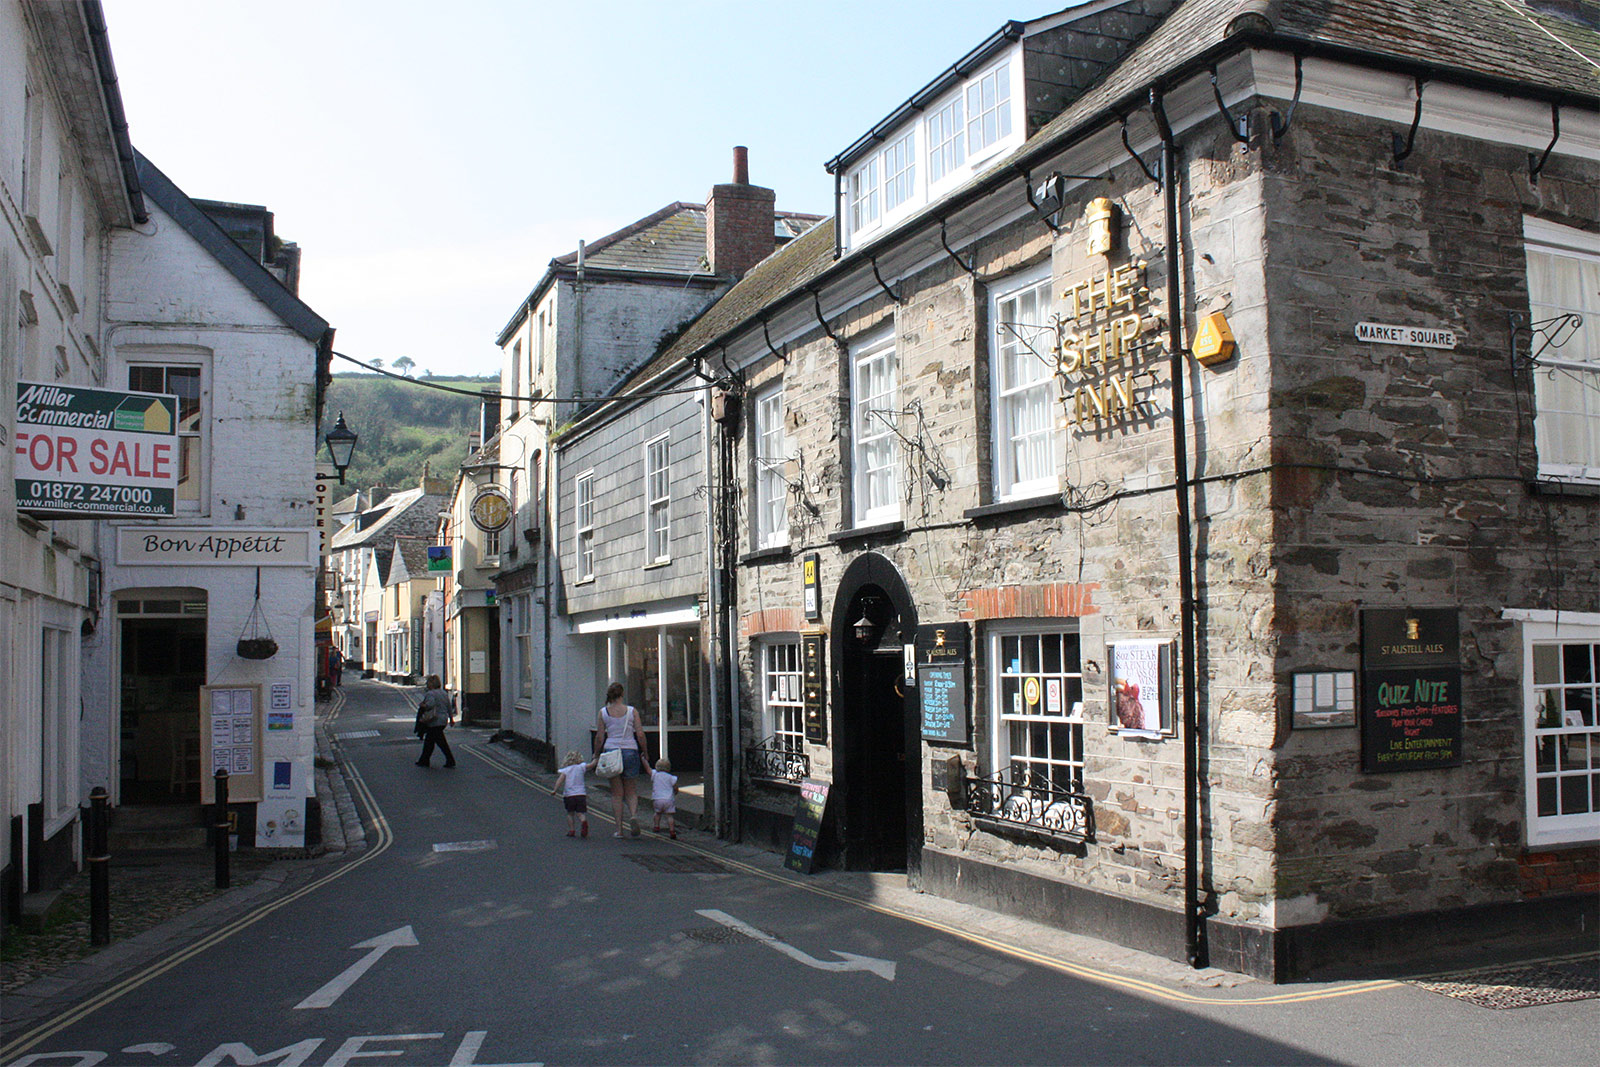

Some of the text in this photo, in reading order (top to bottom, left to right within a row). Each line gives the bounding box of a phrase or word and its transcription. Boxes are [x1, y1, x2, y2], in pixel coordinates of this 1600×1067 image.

[1062, 262, 1134, 320] THE
[1060, 313, 1142, 373] SHIP
[1360, 325, 1453, 345] MARKET SQUARE
[17, 385, 76, 407] Miller
[1074, 371, 1134, 425] INN
[89, 438, 171, 479] SALE
[30, 481, 152, 504] 01872 247000
[143, 534, 286, 559] Bon Appétit
[1130, 649, 1157, 661] STEAK
[1391, 644, 1424, 654] AUSTELL
[1425, 643, 1444, 653] ALES
[1378, 682, 1411, 708] QUIZ
[1414, 679, 1448, 702] NITE
